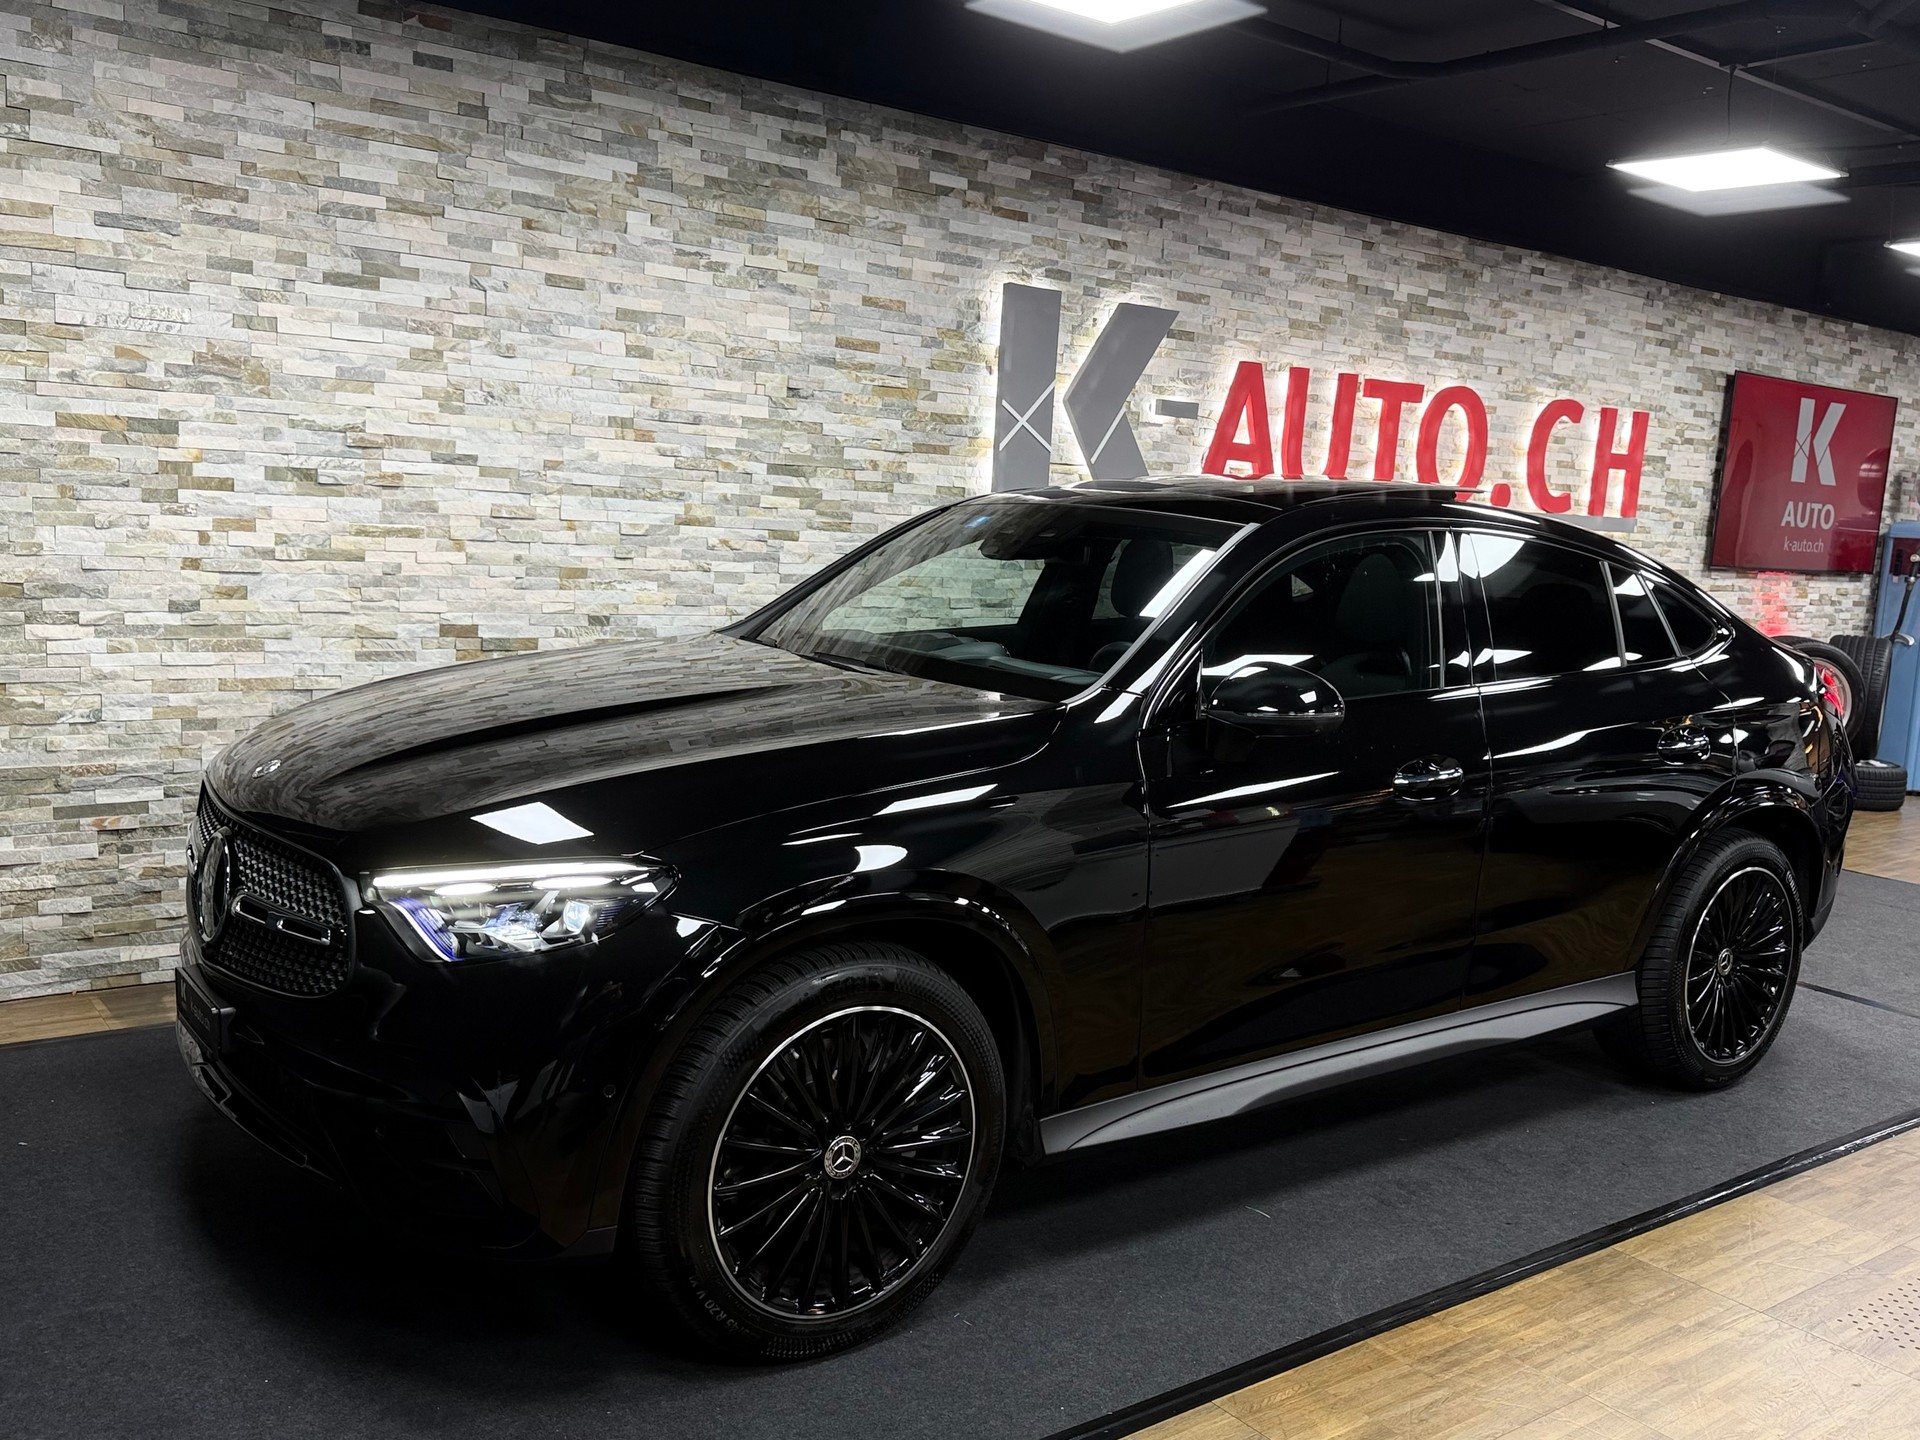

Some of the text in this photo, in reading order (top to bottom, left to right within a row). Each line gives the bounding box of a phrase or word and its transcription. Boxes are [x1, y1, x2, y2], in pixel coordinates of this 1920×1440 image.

[1790, 397, 1847, 486] K
[1781, 501, 1835, 529] AUTO
[1784, 536, 1824, 552] k-auto.ch
